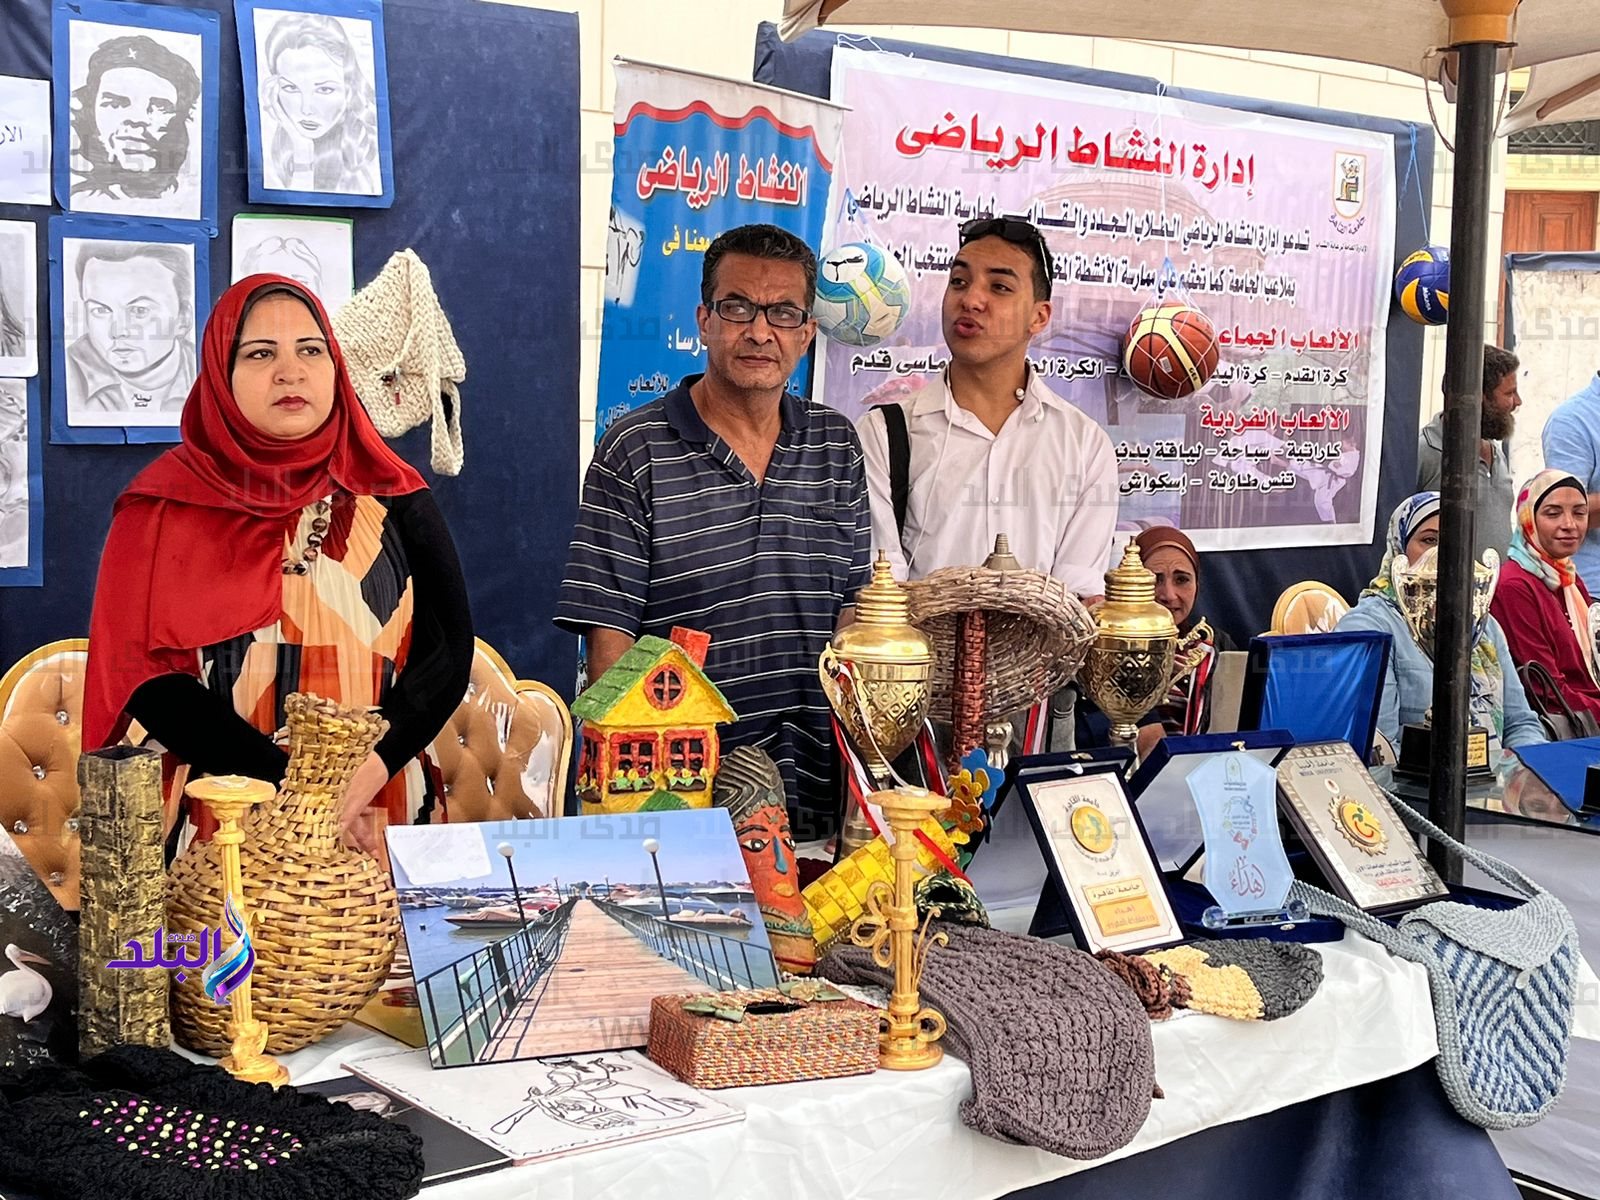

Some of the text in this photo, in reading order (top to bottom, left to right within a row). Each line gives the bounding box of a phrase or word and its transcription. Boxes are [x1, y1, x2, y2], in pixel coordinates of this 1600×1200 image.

[1067, 125, 1185, 175] النشاط
[737, 154, 808, 207] النشاط
[1192, 143, 1255, 198] إدارة
[906, 186, 951, 216] النشاط
[1001, 202, 1088, 236] والقدام
[1183, 220, 1223, 252] الرياضي
[1224, 220, 1258, 245] النشاط
[1209, 269, 1225, 291] كما
[1228, 269, 1264, 300] الجامعة
[1291, 327, 1360, 354] الألعاب
[851, 350, 892, 374] قدم
[1057, 358, 1102, 380] الكرة
[1243, 365, 1267, 385] كرة
[1284, 367, 1321, 386] القدم
[1323, 369, 1348, 387] كرة
[1202, 405, 1350, 435] الألعاب الفردية
[1154, 442, 1203, 463] لياقة
[1221, 442, 1270, 463] سباحة
[1119, 472, 1295, 493] تنس طاولة إسكواش
